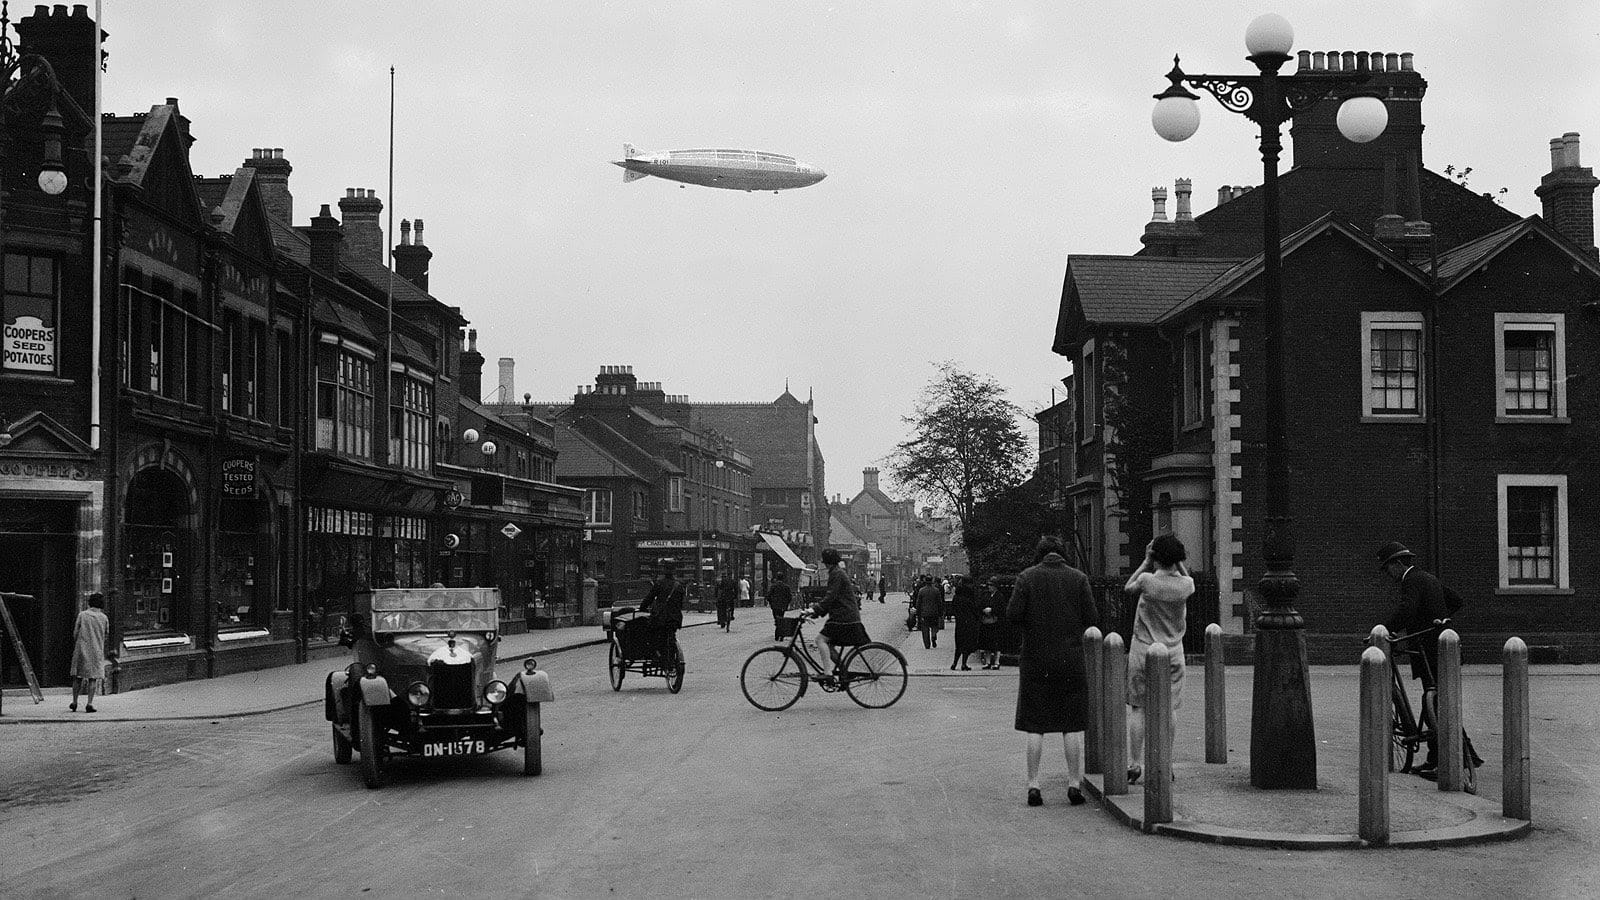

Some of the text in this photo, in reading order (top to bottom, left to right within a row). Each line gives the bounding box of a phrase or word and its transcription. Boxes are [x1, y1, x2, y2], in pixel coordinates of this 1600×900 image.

[4, 326, 53, 341] COOPERS
[12, 341, 45, 351] SEED
[4, 350, 53, 365] POTATOES
[223, 459, 254, 471] COOPERS
[224, 473, 253, 481] TESTED
[223, 483, 253, 494] SEEDS
